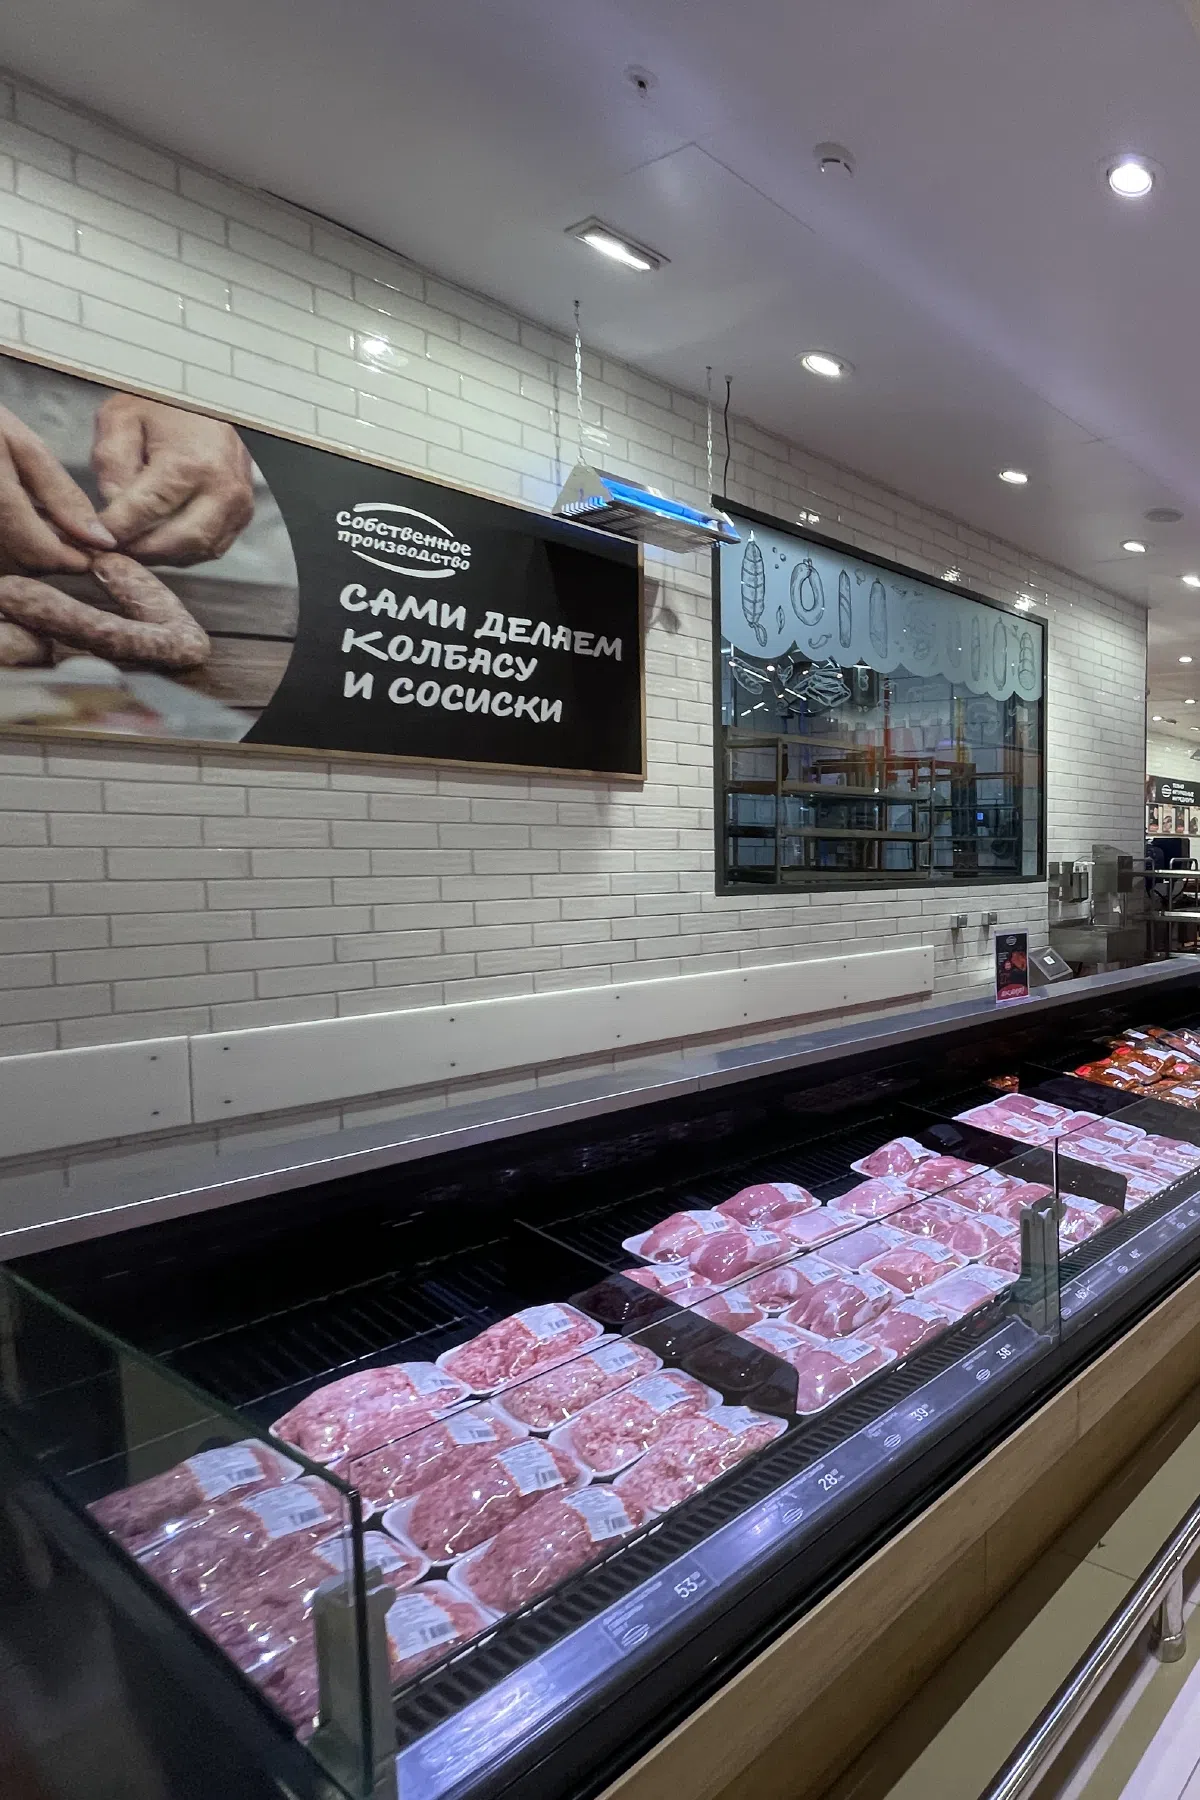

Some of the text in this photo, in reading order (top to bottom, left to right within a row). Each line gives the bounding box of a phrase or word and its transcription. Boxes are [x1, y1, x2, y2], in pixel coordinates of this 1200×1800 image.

[336, 511, 472, 556] Собственное
[337, 530, 470, 571] производство
[339, 584, 623, 661] САМИ ДЕЛАЕМ
[341, 628, 538, 682] КОЛБАСУ
[343, 671, 563, 723] И СОСИСКИ
